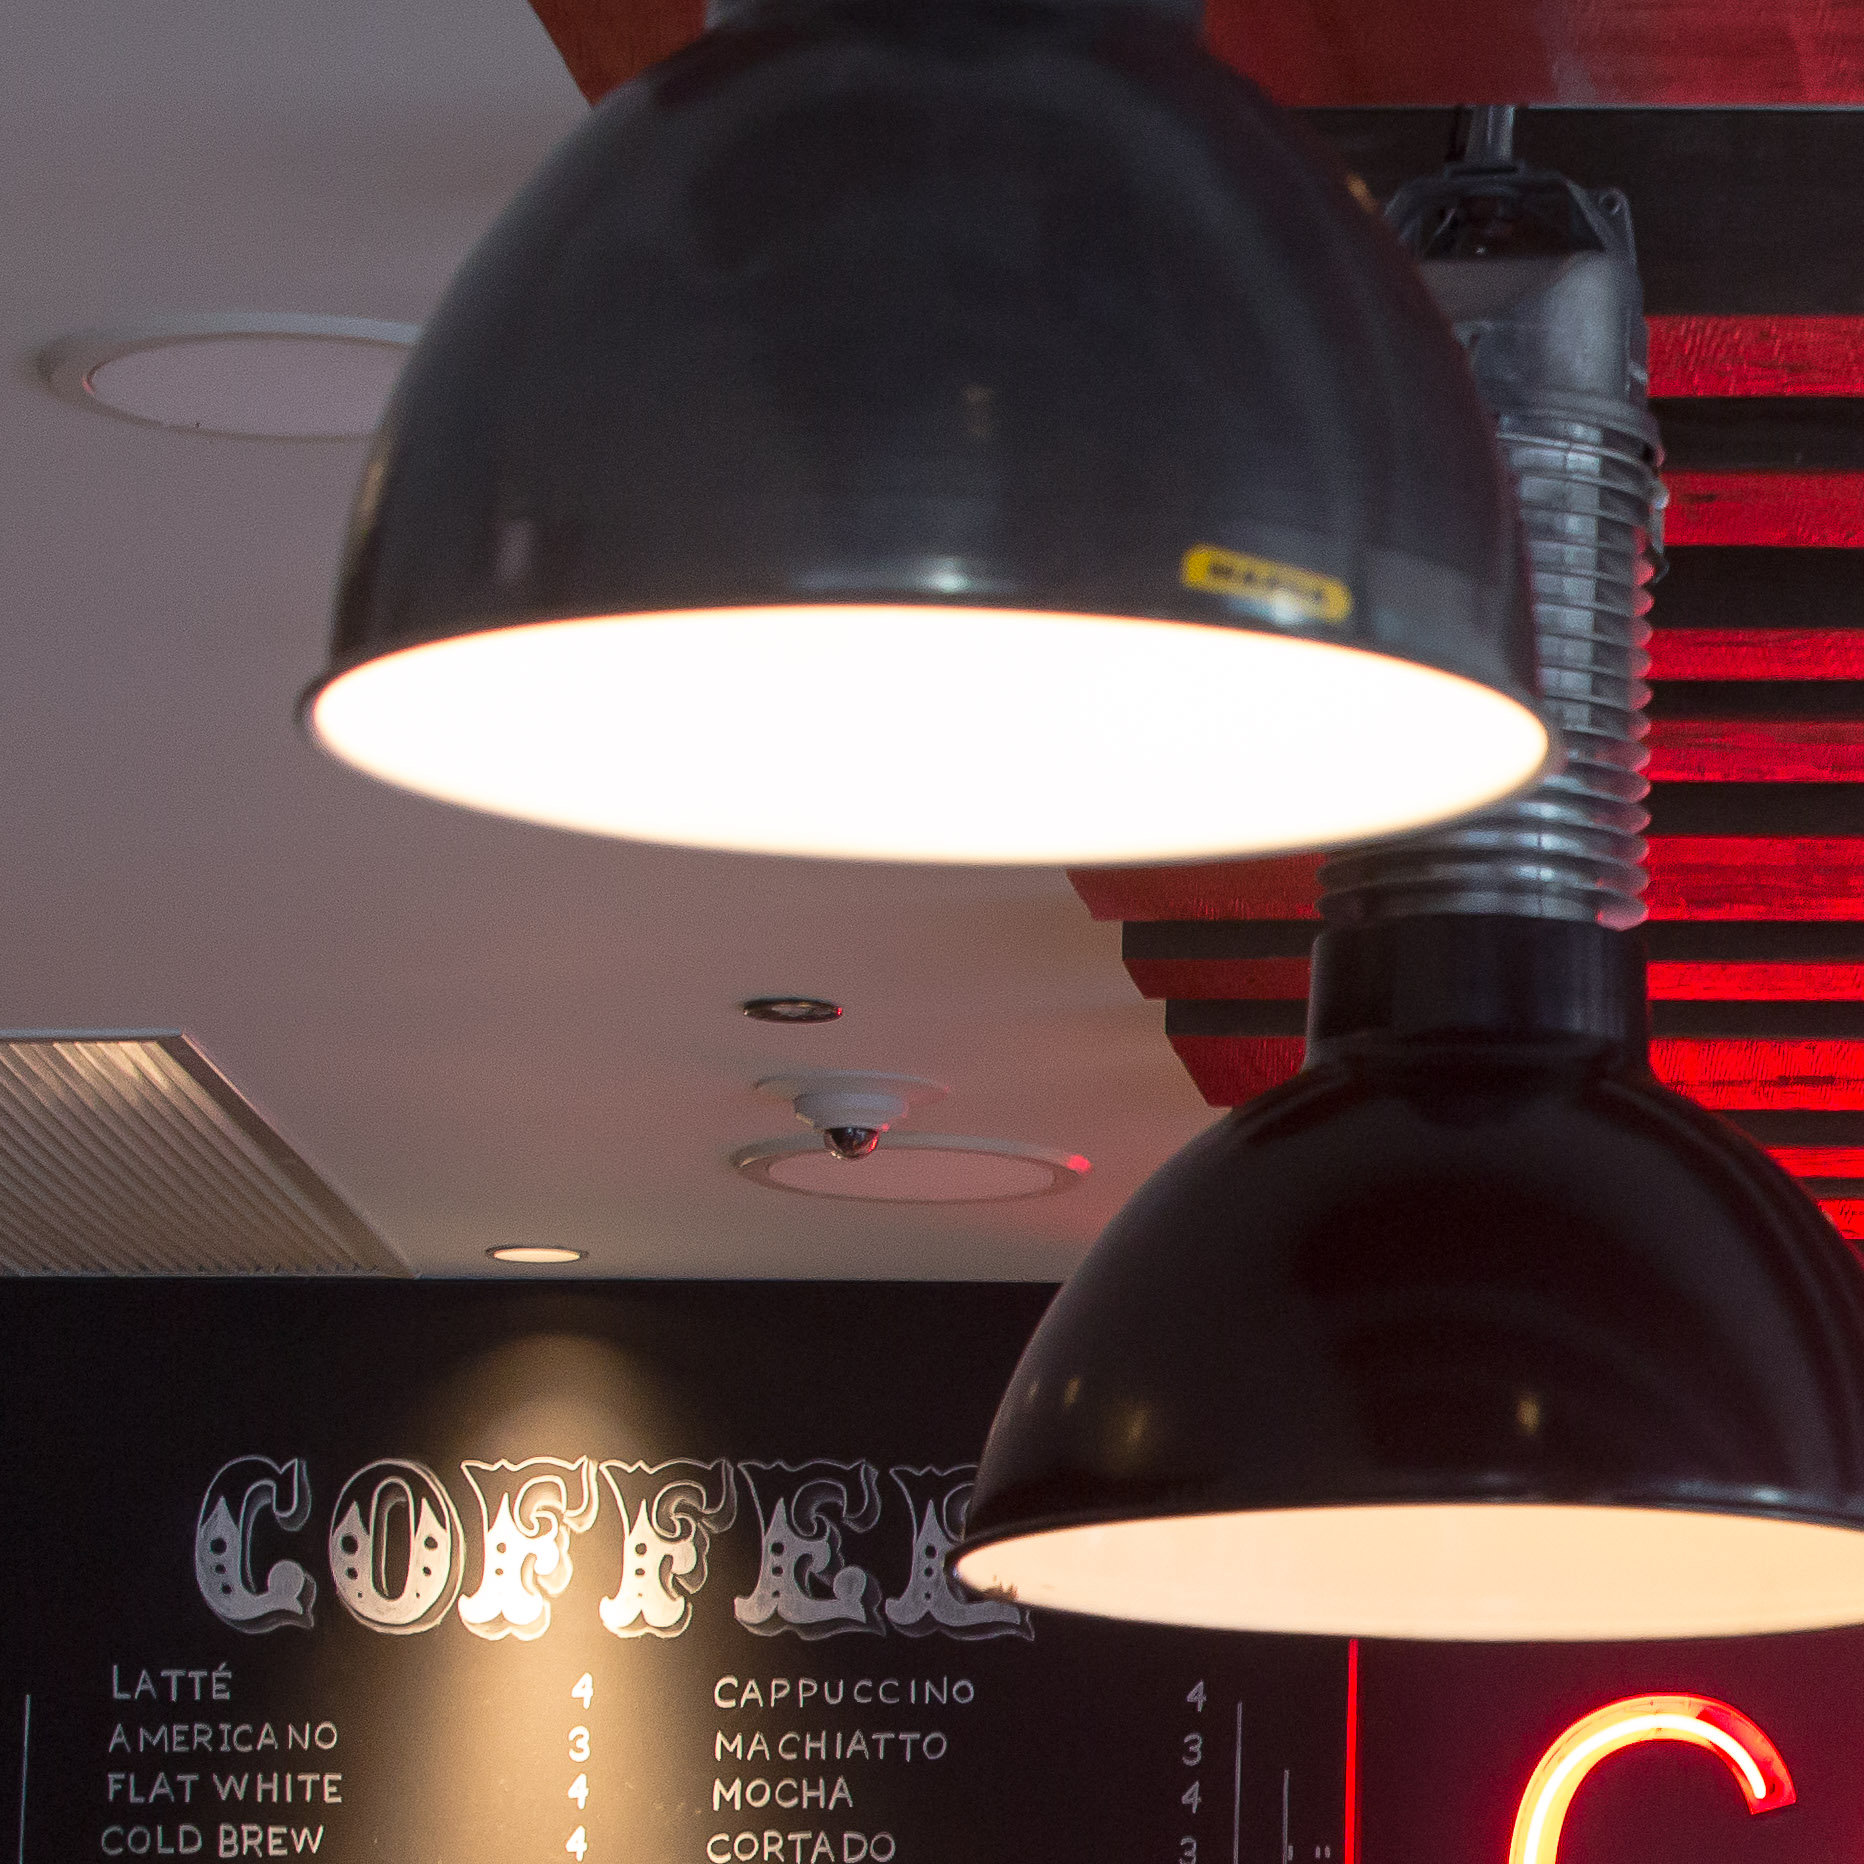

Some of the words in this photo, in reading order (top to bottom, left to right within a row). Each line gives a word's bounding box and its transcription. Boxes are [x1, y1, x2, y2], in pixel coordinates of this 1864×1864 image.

[110, 1662, 234, 1702] LATTÉ
[573, 1674, 592, 1707] 4
[714, 1676, 974, 1708] CAPPUCCINO
[108, 1721, 337, 1752] AMERICANO
[570, 1727, 589, 1761] 3
[715, 1731, 947, 1762] MACHIATTO
[107, 1772, 199, 1803] FLAT
[213, 1772, 341, 1803] WHITE
[713, 1777, 852, 1810] MOCHA
[101, 1824, 202, 1855] COLD
[218, 1824, 323, 1858] BREW
[707, 1830, 895, 1864] CORTADO
